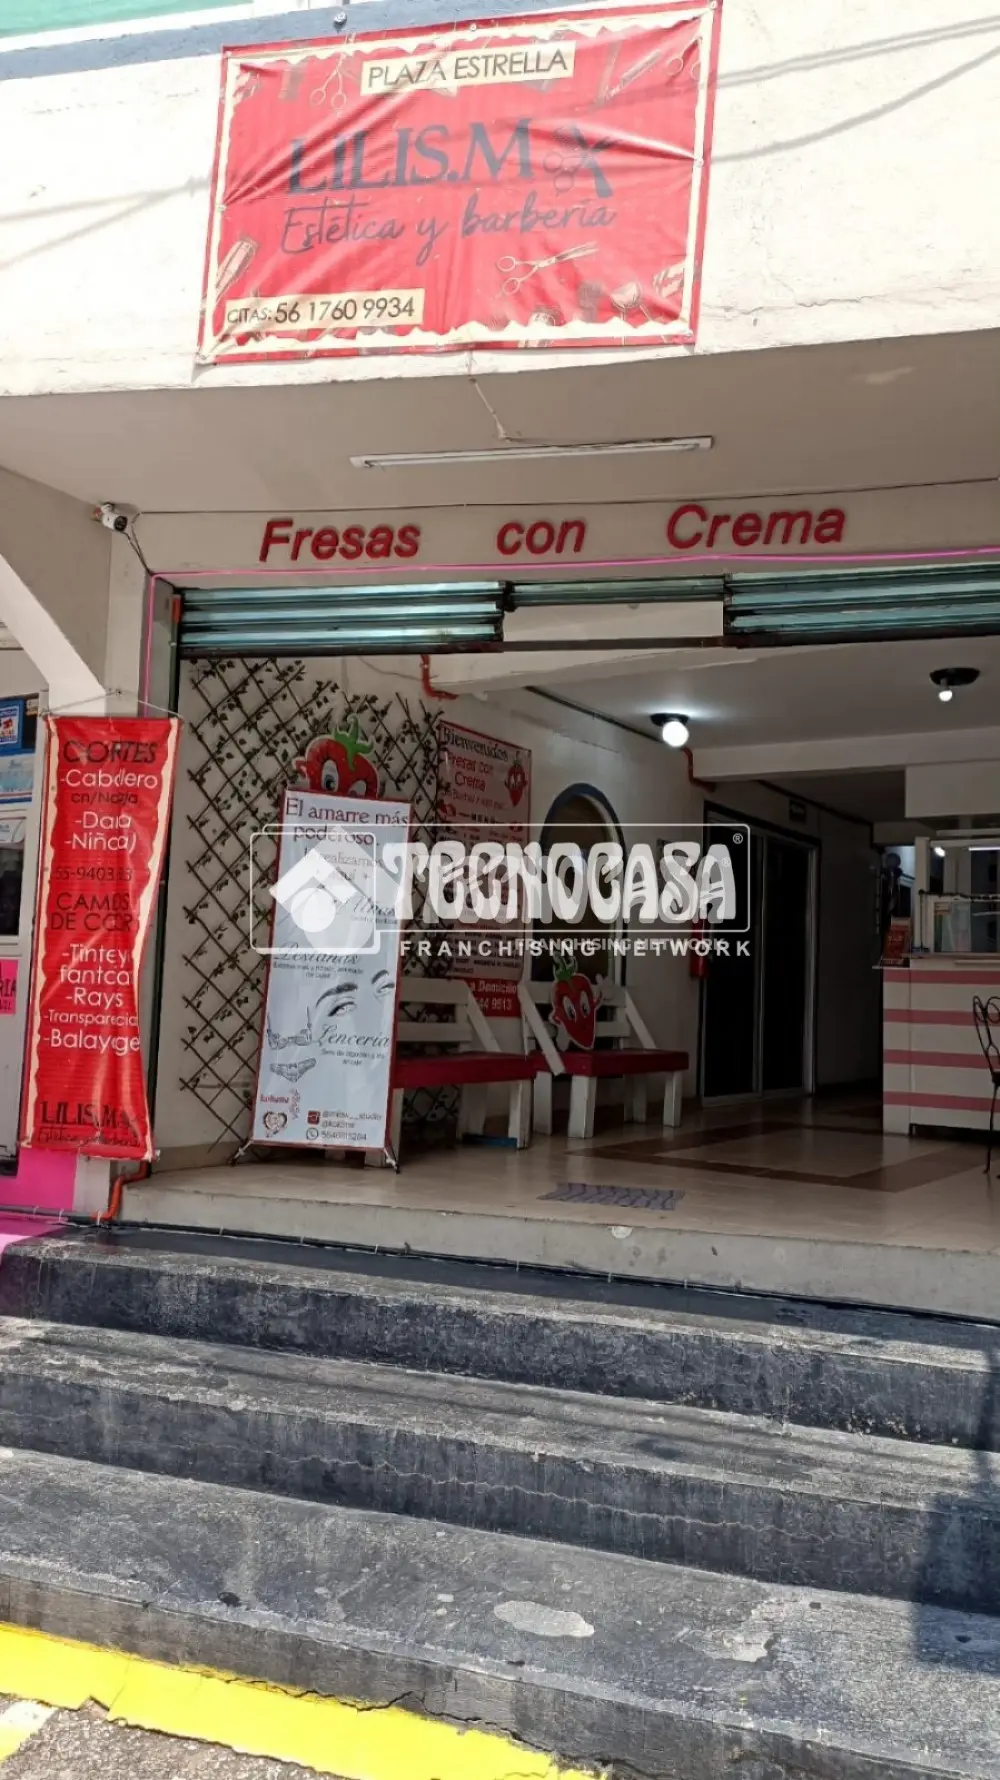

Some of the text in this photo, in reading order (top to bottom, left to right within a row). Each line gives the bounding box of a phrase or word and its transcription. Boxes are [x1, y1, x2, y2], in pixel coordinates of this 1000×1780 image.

[368, 48, 569, 88] PLAZA ESTRELLA
[281, 190, 617, 266] Estética y barbería
[227, 297, 415, 324] CITAS: 56 1760 9934
[258, 503, 846, 562] Fresas con Crema
[286, 797, 304, 817] El
[308, 806, 370, 824] amarre
[51, 912, 77, 930] DE
